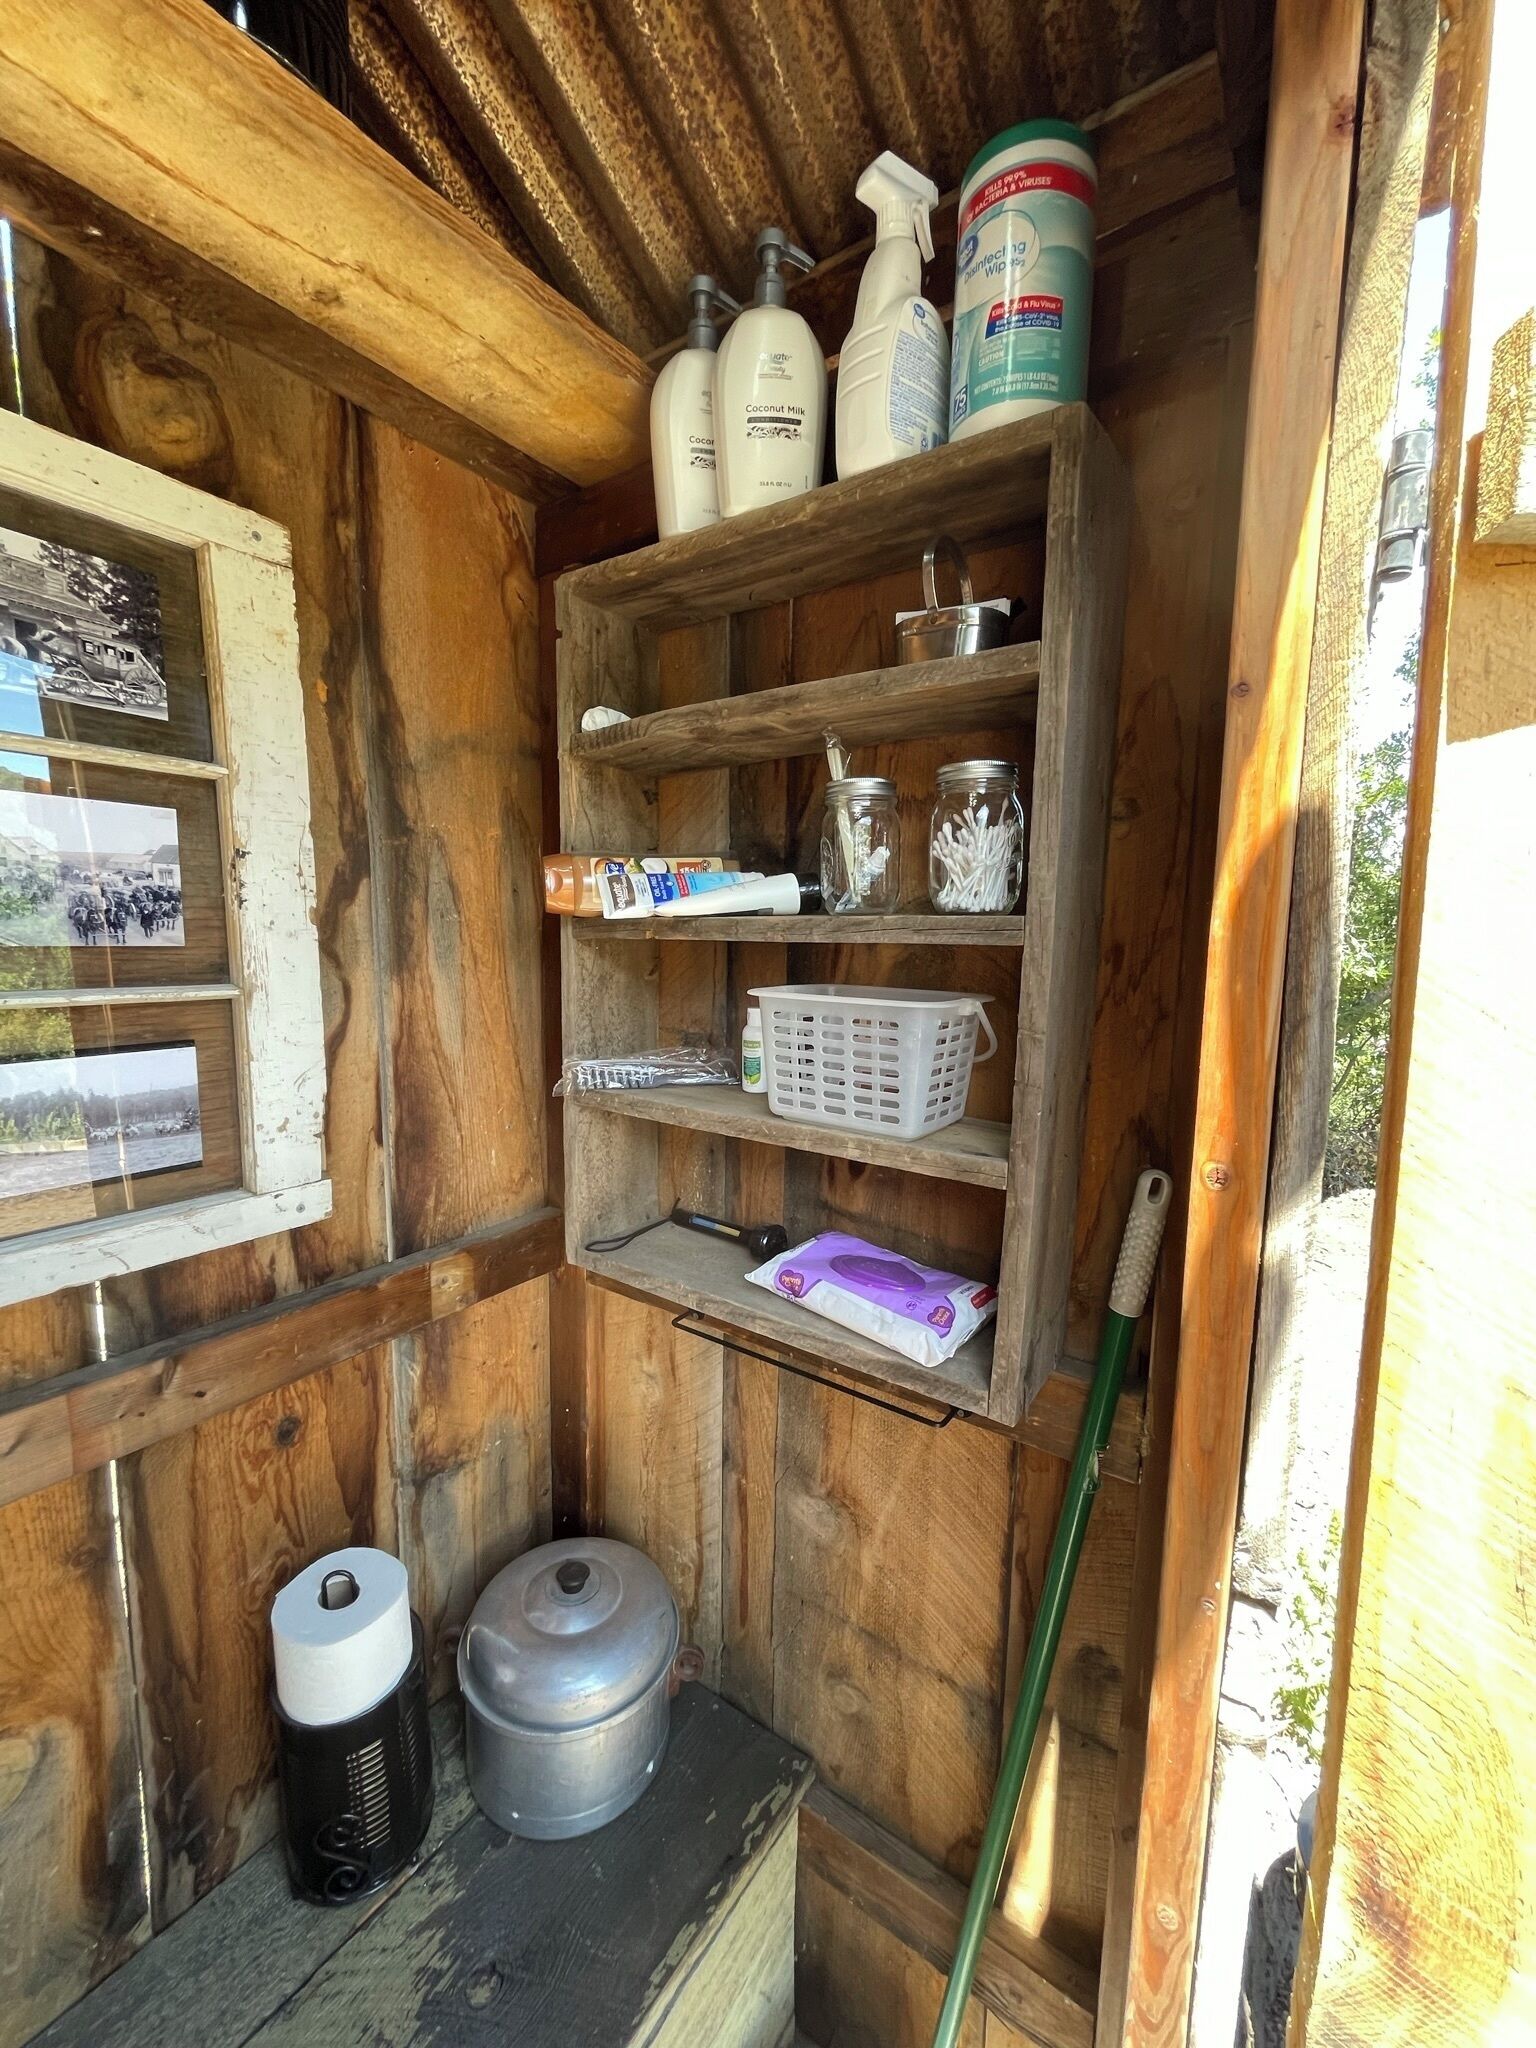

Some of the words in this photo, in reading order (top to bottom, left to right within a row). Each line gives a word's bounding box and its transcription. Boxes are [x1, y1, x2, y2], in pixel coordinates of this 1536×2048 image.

[984, 179, 1003, 197] KILLS
[1003, 170, 1027, 185] 99.9%
[975, 186, 1009, 215] BACTERIA
[964, 240, 1027, 284] Disinfectng
[1029, 300, 1040, 308] Flu
[1032, 319, 1060, 327] COVID-19
[978, 350, 1005, 367] CAUTION
[745, 404, 785, 414] Coconut
[787, 405, 806, 416] Milk
[954, 388, 967, 411] 75
[612, 882, 626, 909] equate
[650, 876, 661, 897] OIL-FREE
